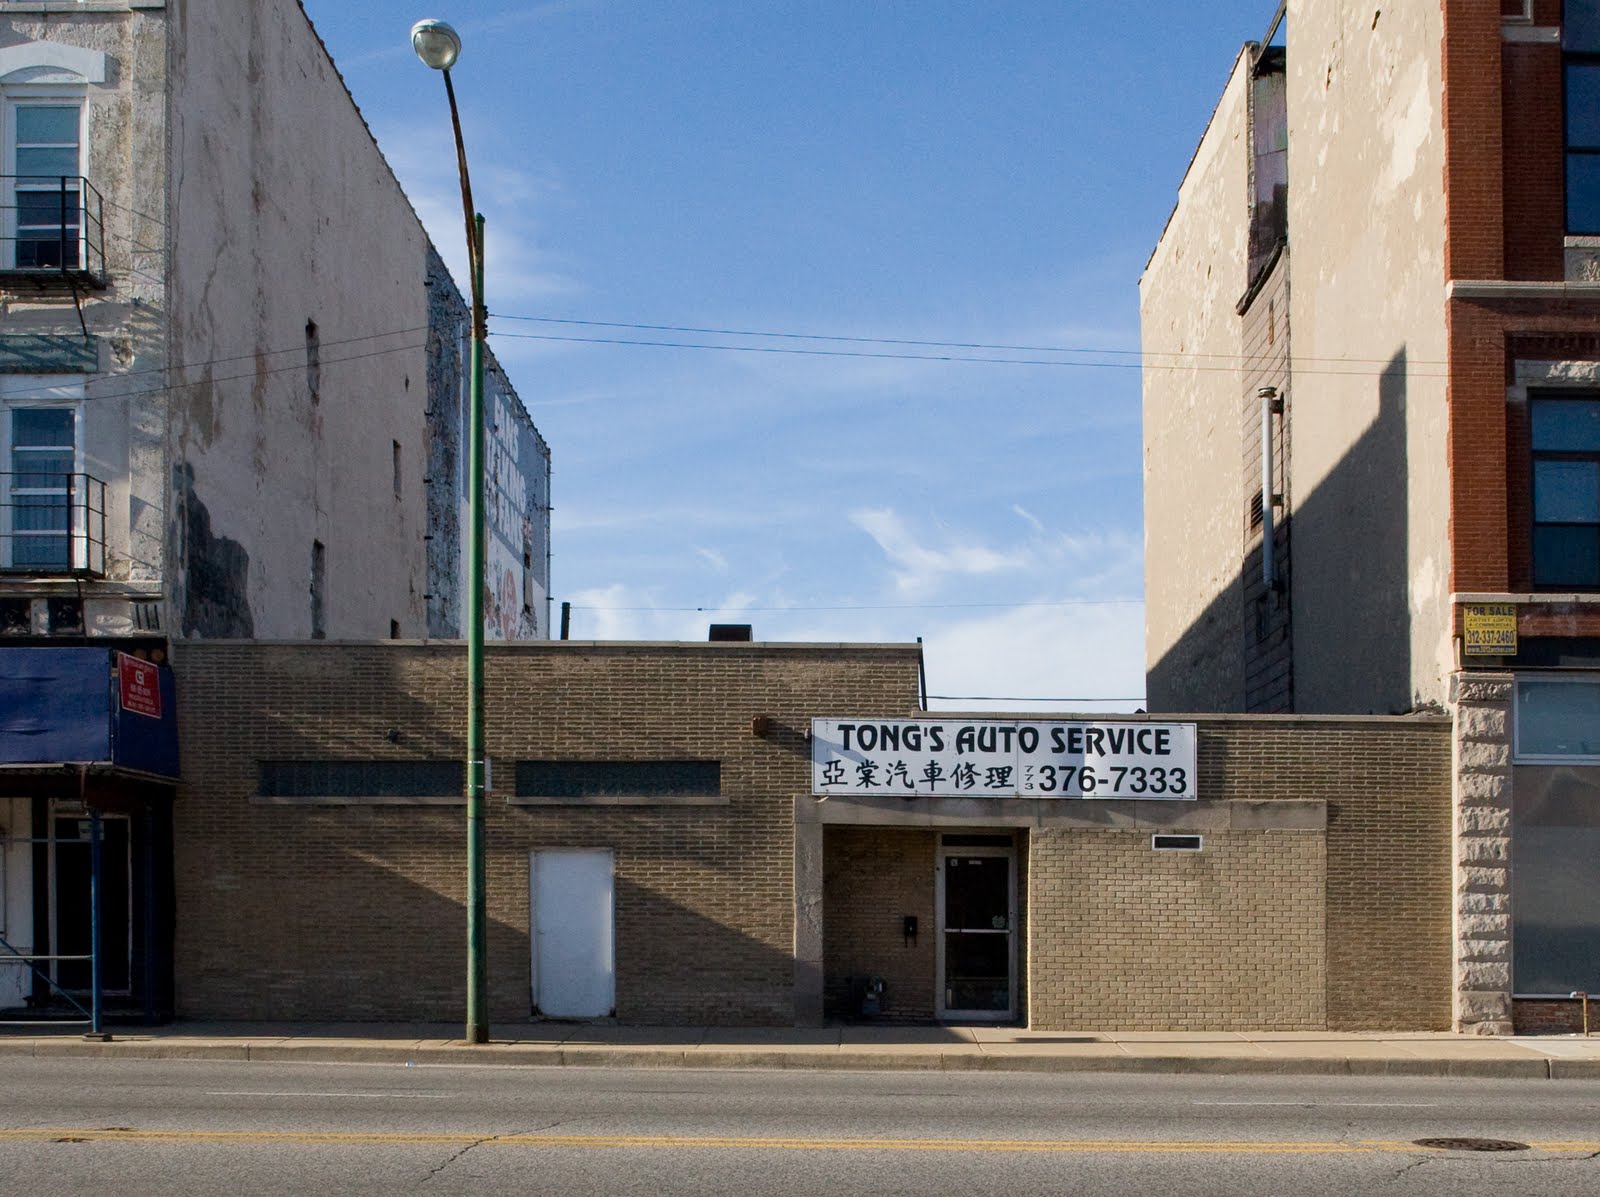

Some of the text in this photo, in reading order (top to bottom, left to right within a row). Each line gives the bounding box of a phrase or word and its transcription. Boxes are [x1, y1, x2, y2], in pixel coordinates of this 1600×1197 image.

[1467, 606, 1514, 616] FOR SALE
[1467, 630, 1515, 644] 312-337-2460
[838, 724, 1171, 758] TONG'S AUTO SERVICE
[1039, 764, 1187, 794] 376-7333
